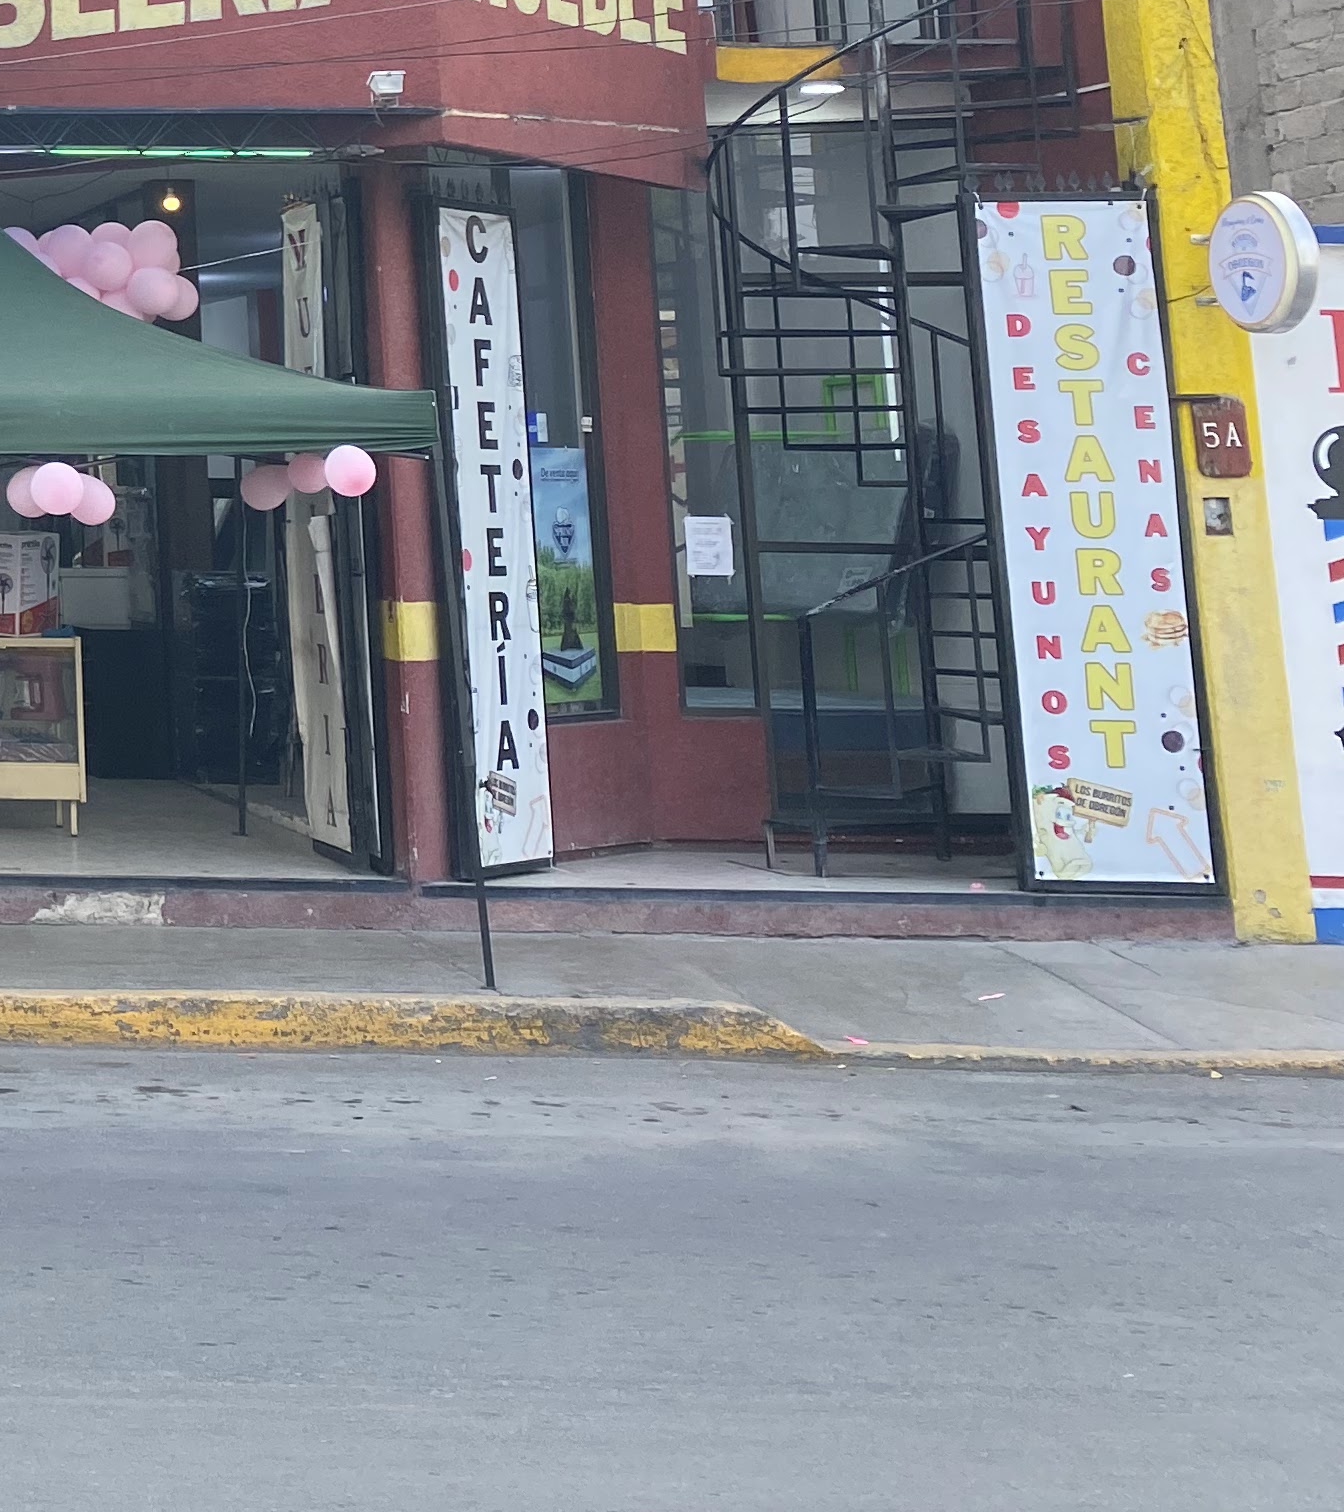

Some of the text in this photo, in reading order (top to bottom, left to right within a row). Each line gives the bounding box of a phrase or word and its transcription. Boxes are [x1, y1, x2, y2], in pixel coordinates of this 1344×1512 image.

[464, 215, 520, 772] CAFETERÍA
[1006, 313, 1071, 770] DESAYUNOS
[1041, 213, 1137, 770] RESTAURANT
[1126, 351, 1172, 592] CENAS
